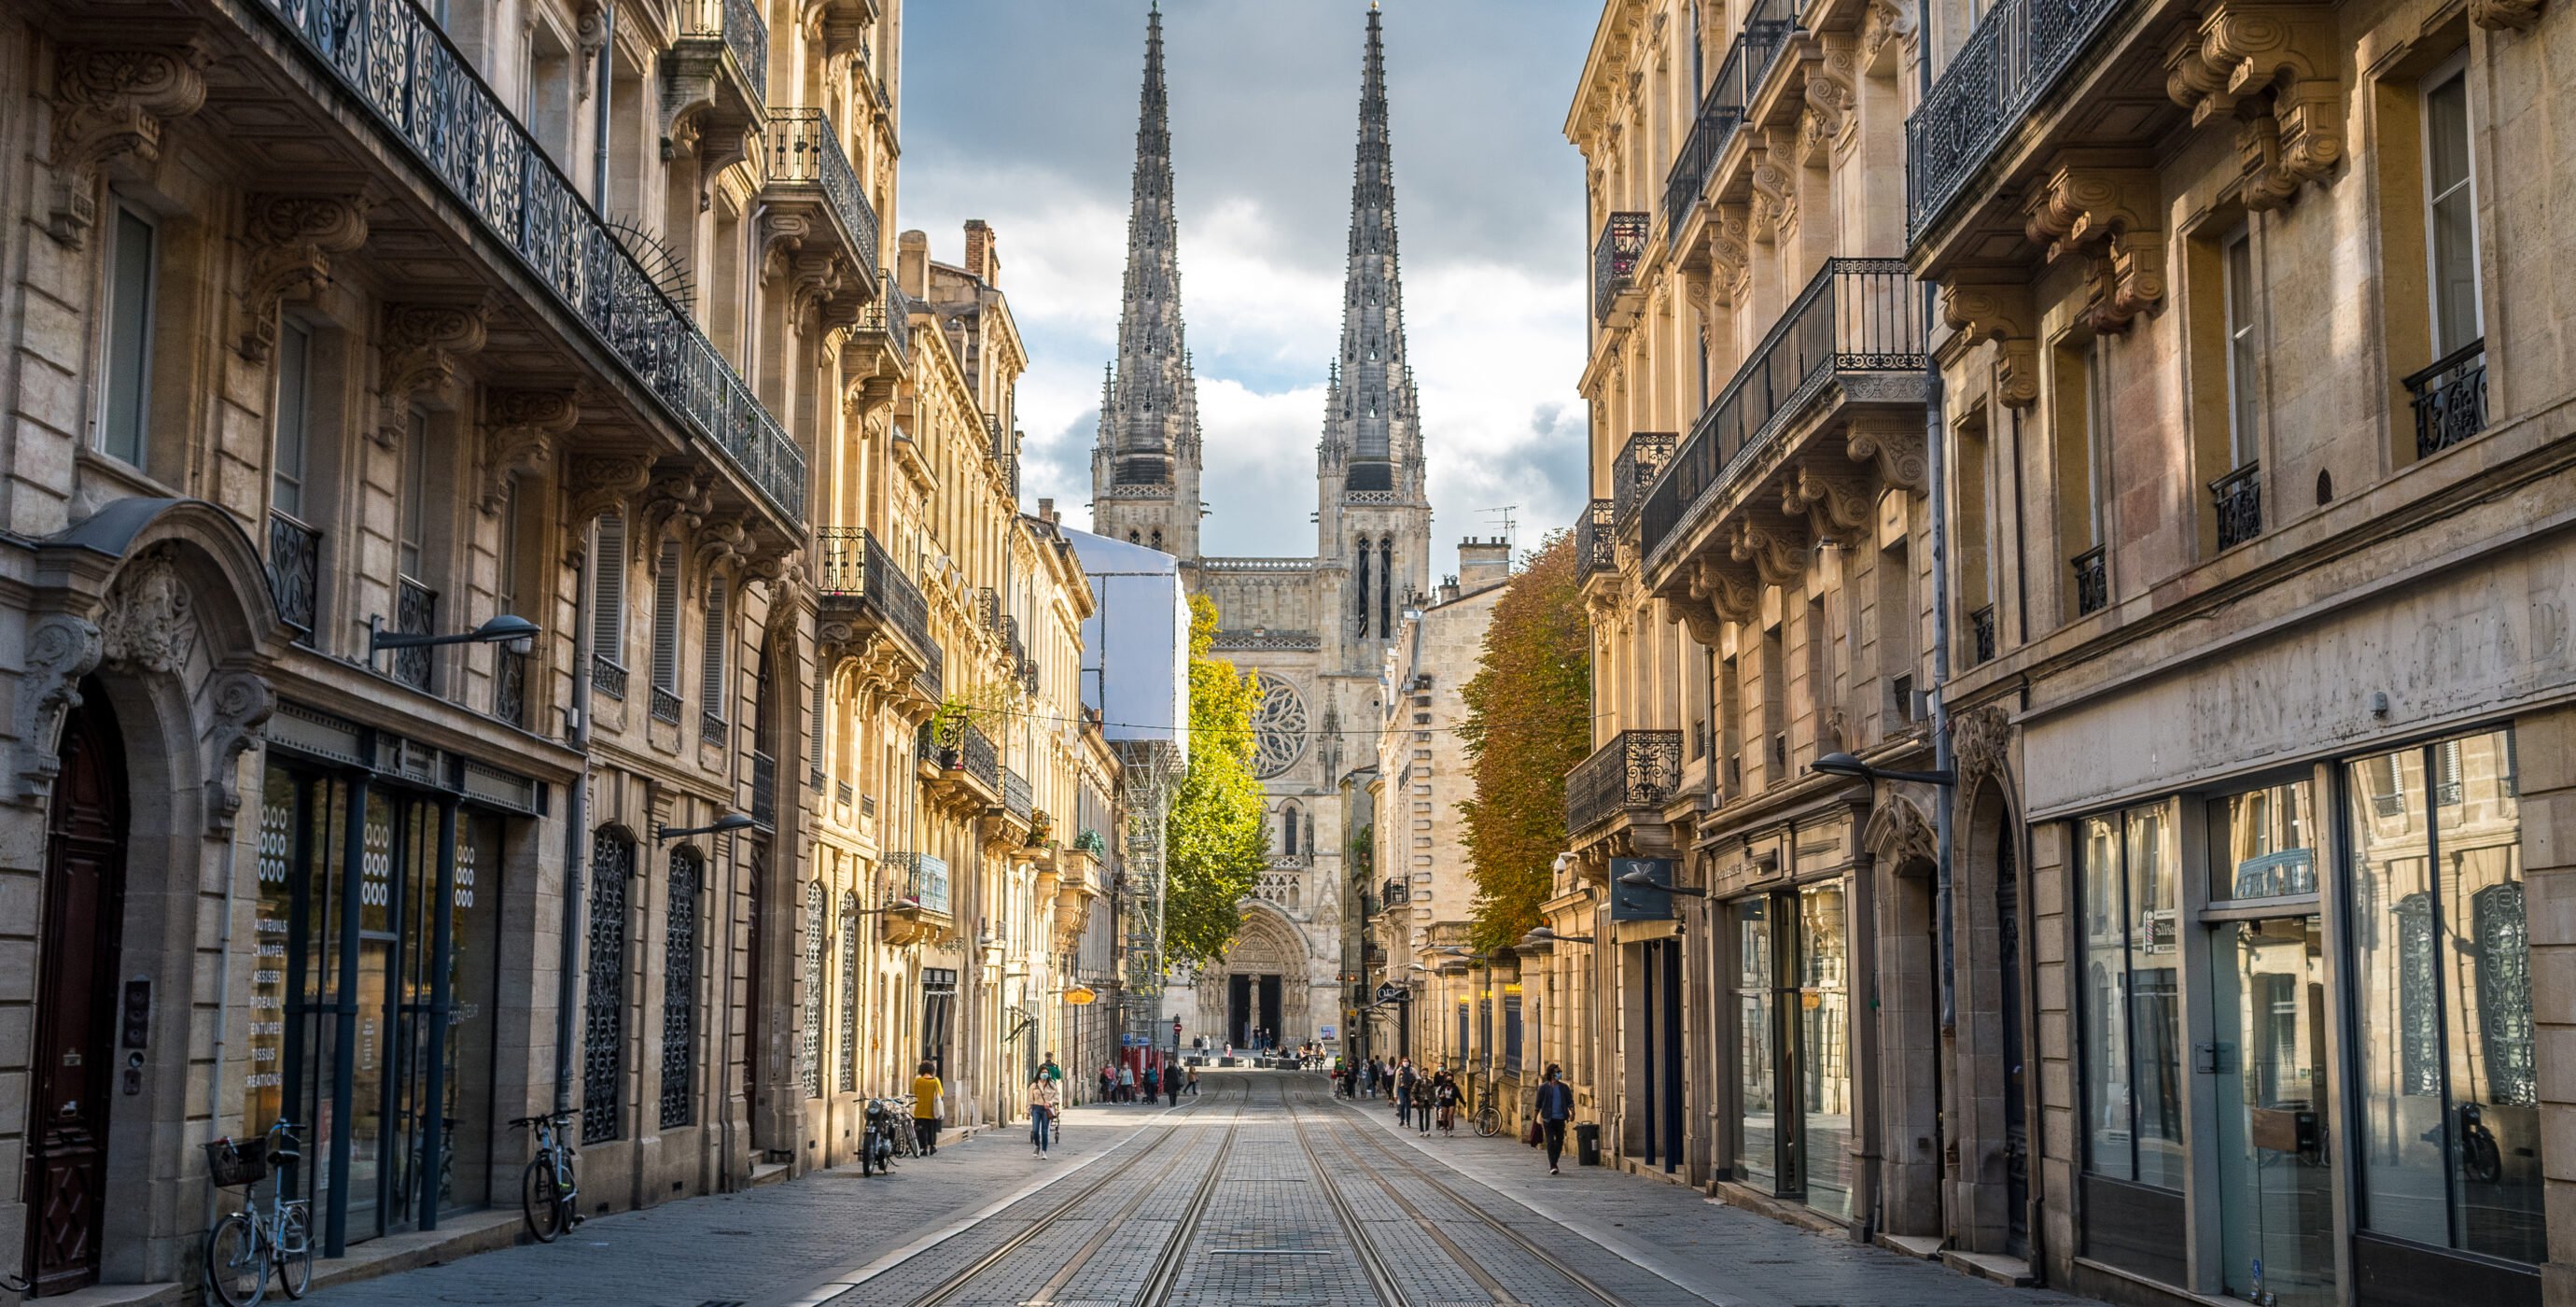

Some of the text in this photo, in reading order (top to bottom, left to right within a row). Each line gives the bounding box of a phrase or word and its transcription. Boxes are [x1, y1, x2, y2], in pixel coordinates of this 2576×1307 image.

[253, 970, 280, 983] ASSISES
[247, 995, 280, 1009] RIDEAUX
[251, 1047, 275, 1061] TISSUS
